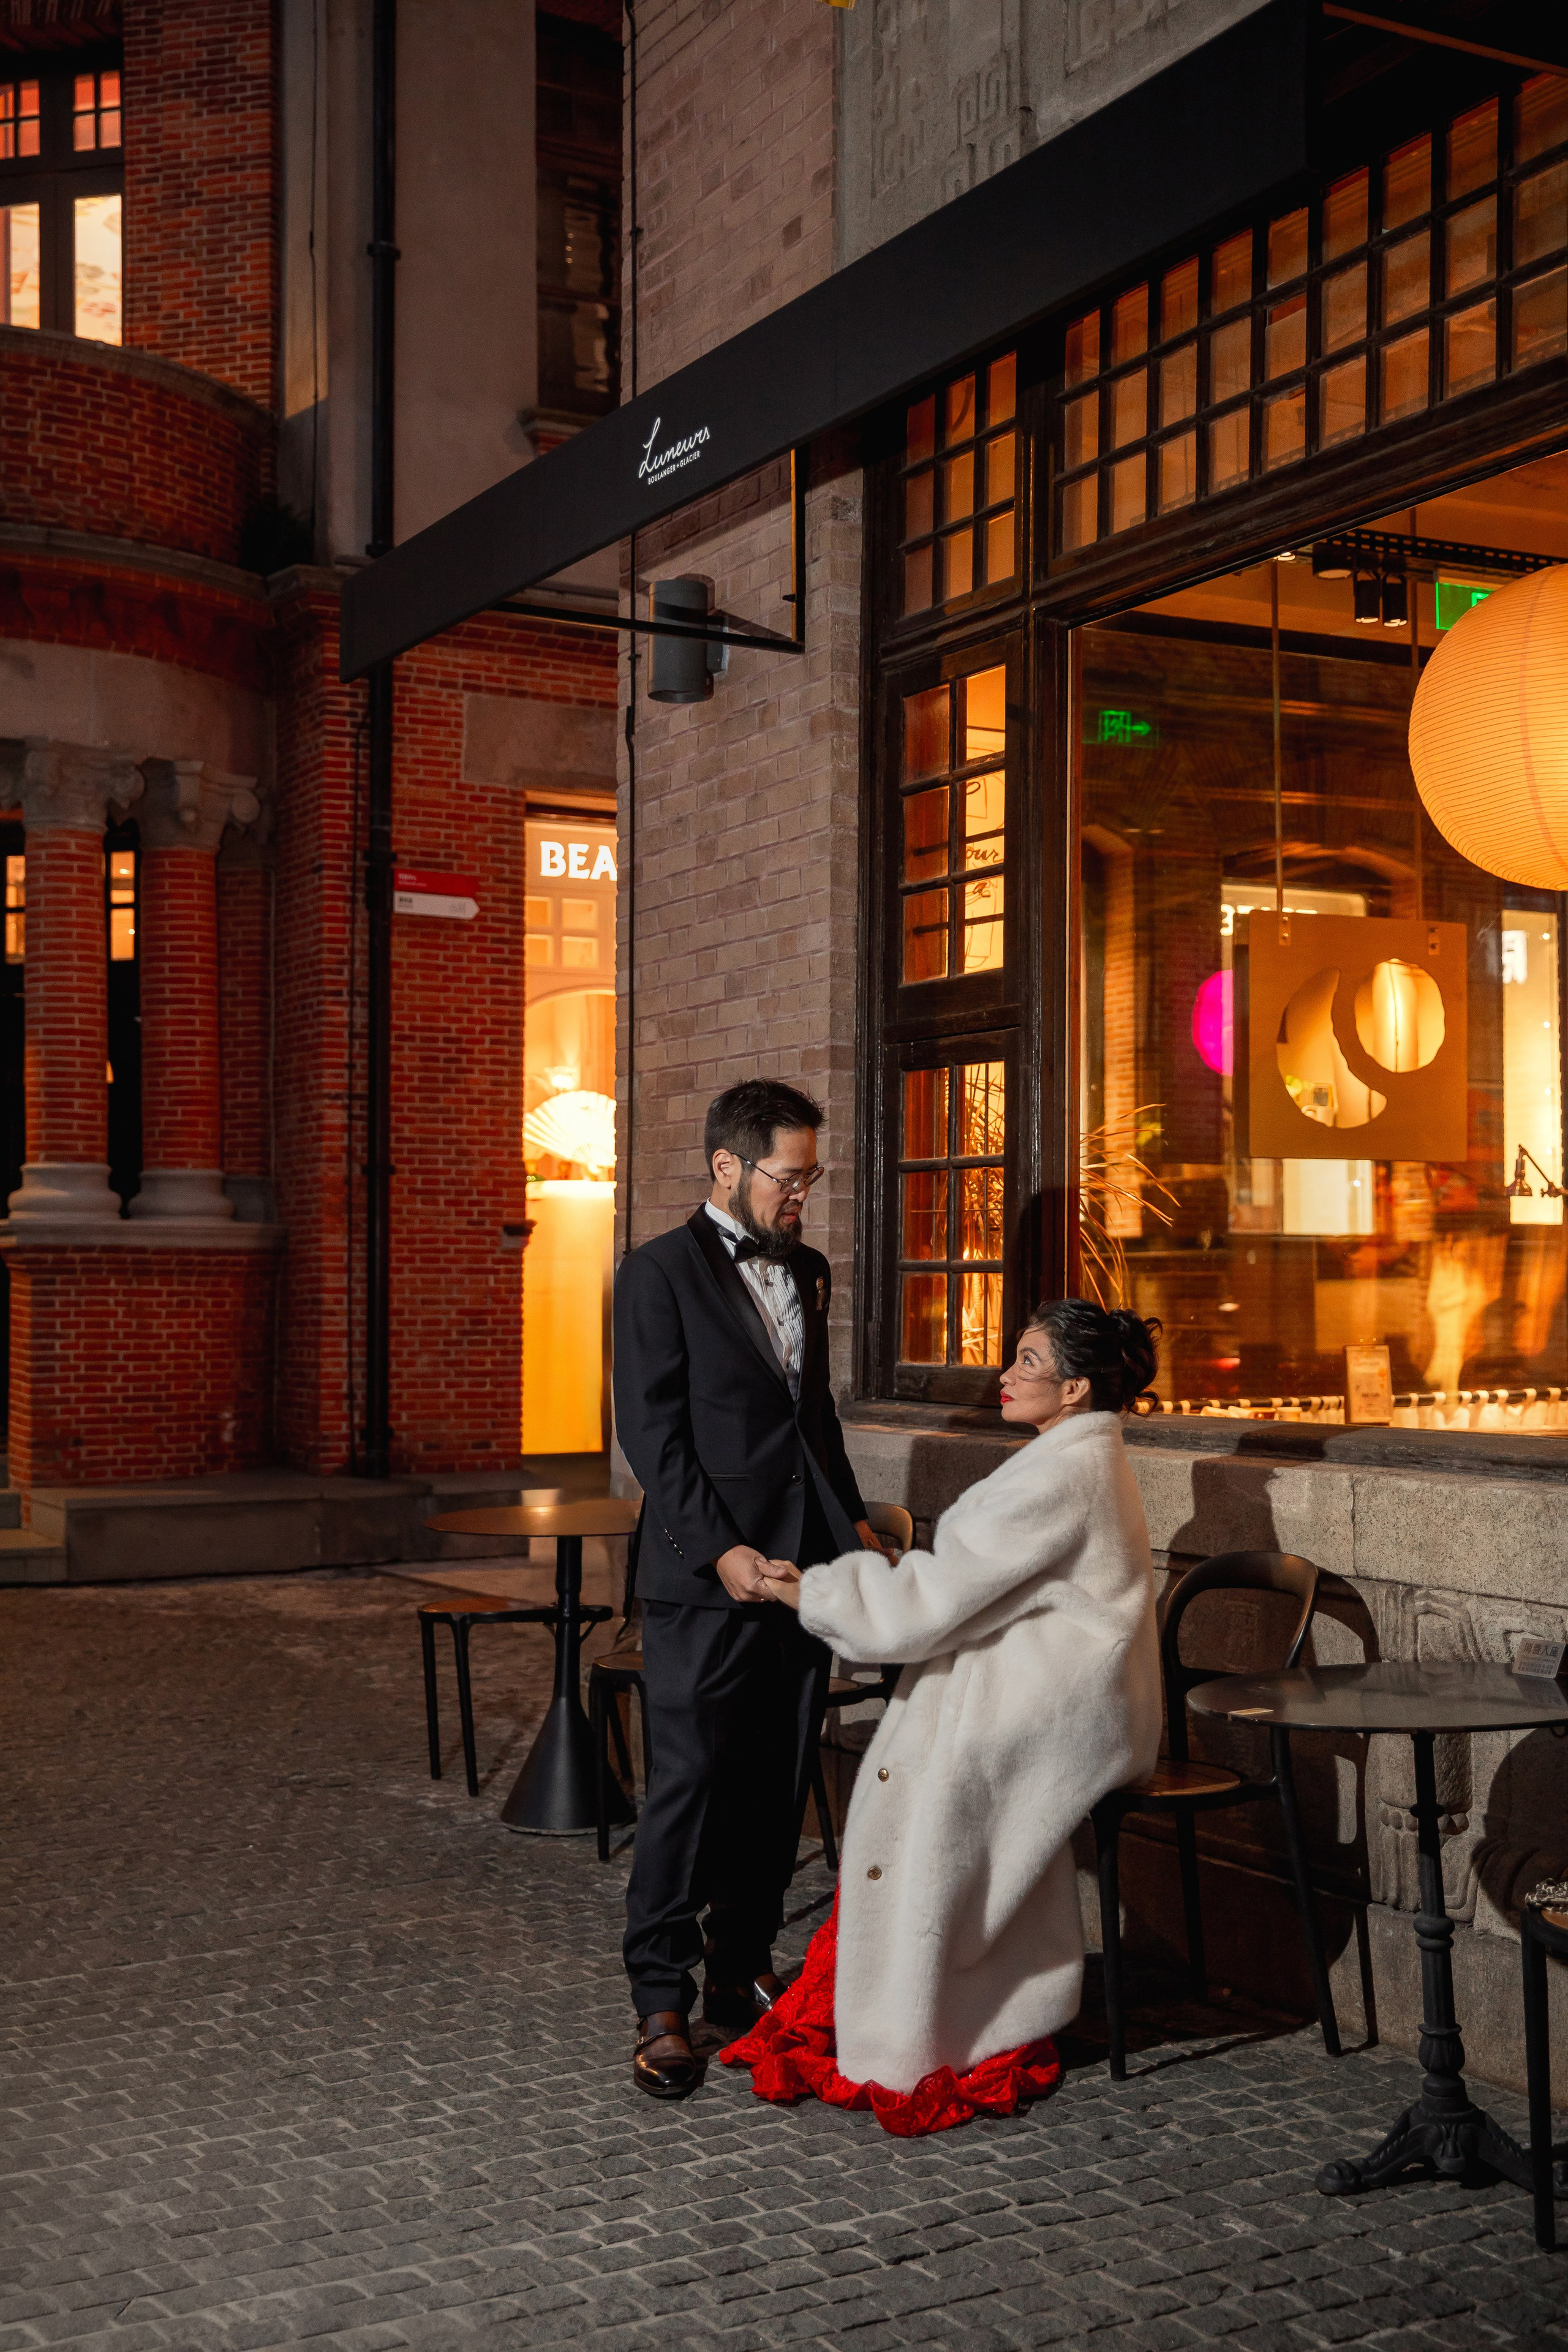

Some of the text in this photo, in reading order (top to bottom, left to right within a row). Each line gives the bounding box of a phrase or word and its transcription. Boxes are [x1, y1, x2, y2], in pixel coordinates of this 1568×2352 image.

[638, 417, 710, 478] Luneurs
[648, 464, 676, 484] BOULANGER
[680, 451, 700, 467] GLACIER
[540, 840, 618, 881] BEA
[1523, 1642, 1559, 1657] 消费入座
